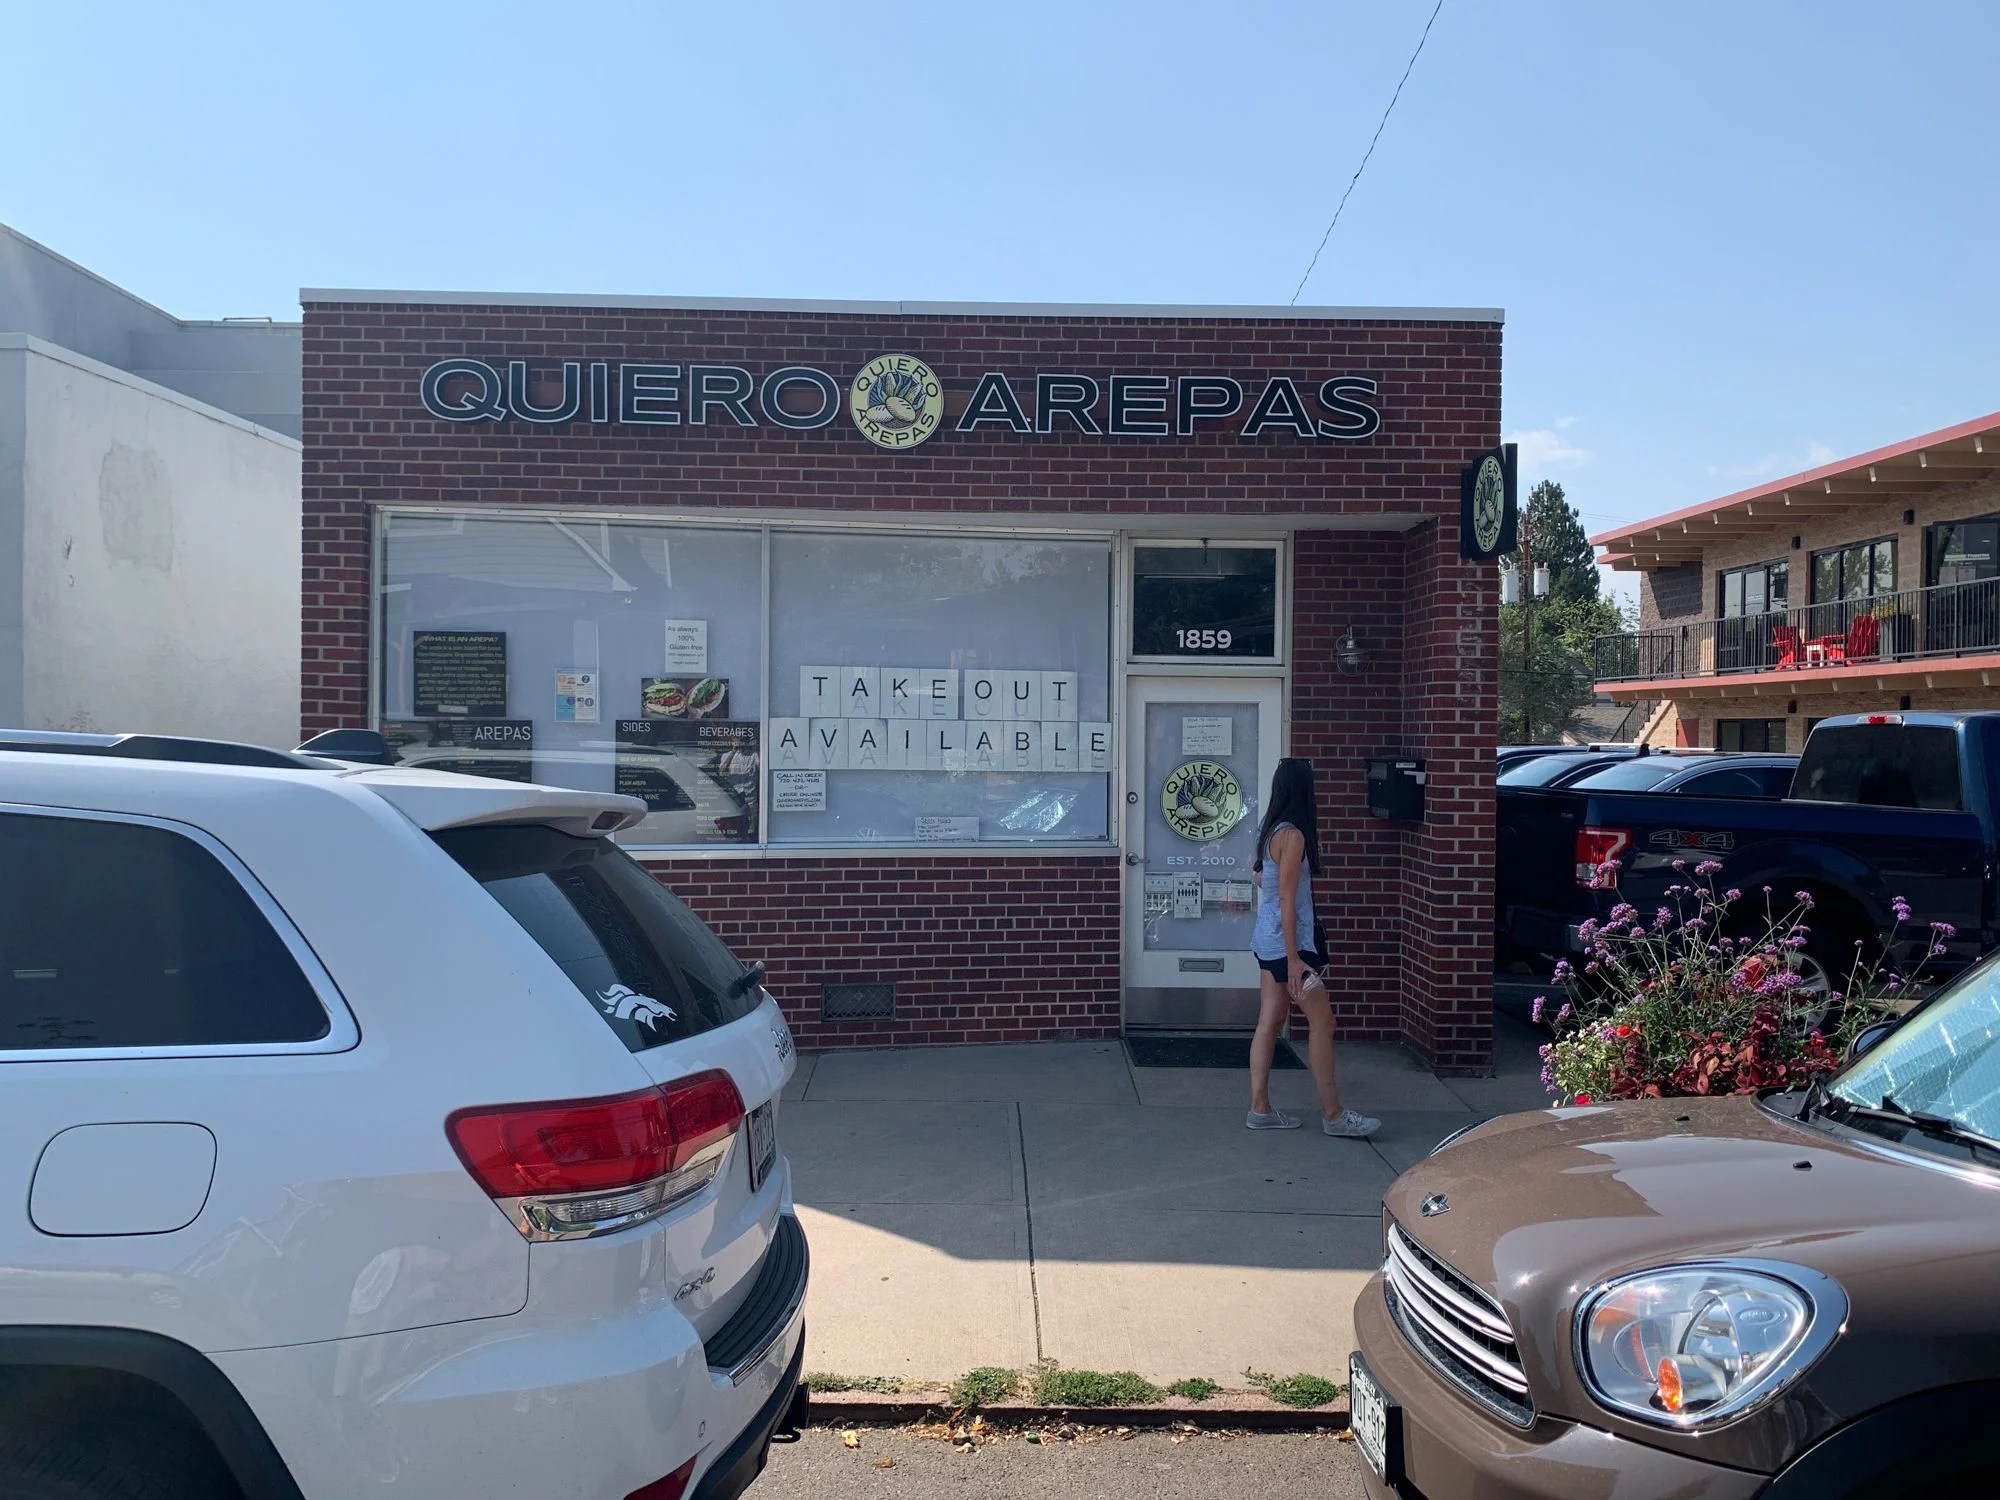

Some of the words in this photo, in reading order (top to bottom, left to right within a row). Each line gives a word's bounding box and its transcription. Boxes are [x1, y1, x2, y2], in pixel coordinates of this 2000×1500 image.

[857, 358, 939, 398] QUIERO
[420, 358, 841, 429] QUIERO
[954, 372, 1381, 439] AREPAS
[856, 407, 935, 445] AREPAS
[1475, 460, 1502, 502] QUIERO
[1176, 629, 1232, 649] 1859
[812, 676, 947, 699] TAKE
[974, 680, 1067, 701] OUT
[474, 726, 531, 741] AREPAS
[622, 722, 651, 732] SIDES
[699, 726, 754, 737] BEVERAGES
[780, 728, 1106, 752] AVAILABLE
[1166, 764, 1238, 796] QUIERO
[1166, 807, 1236, 838] AREPAS
[1167, 856, 1197, 865] EST.
[1201, 856, 1235, 866] 2010
